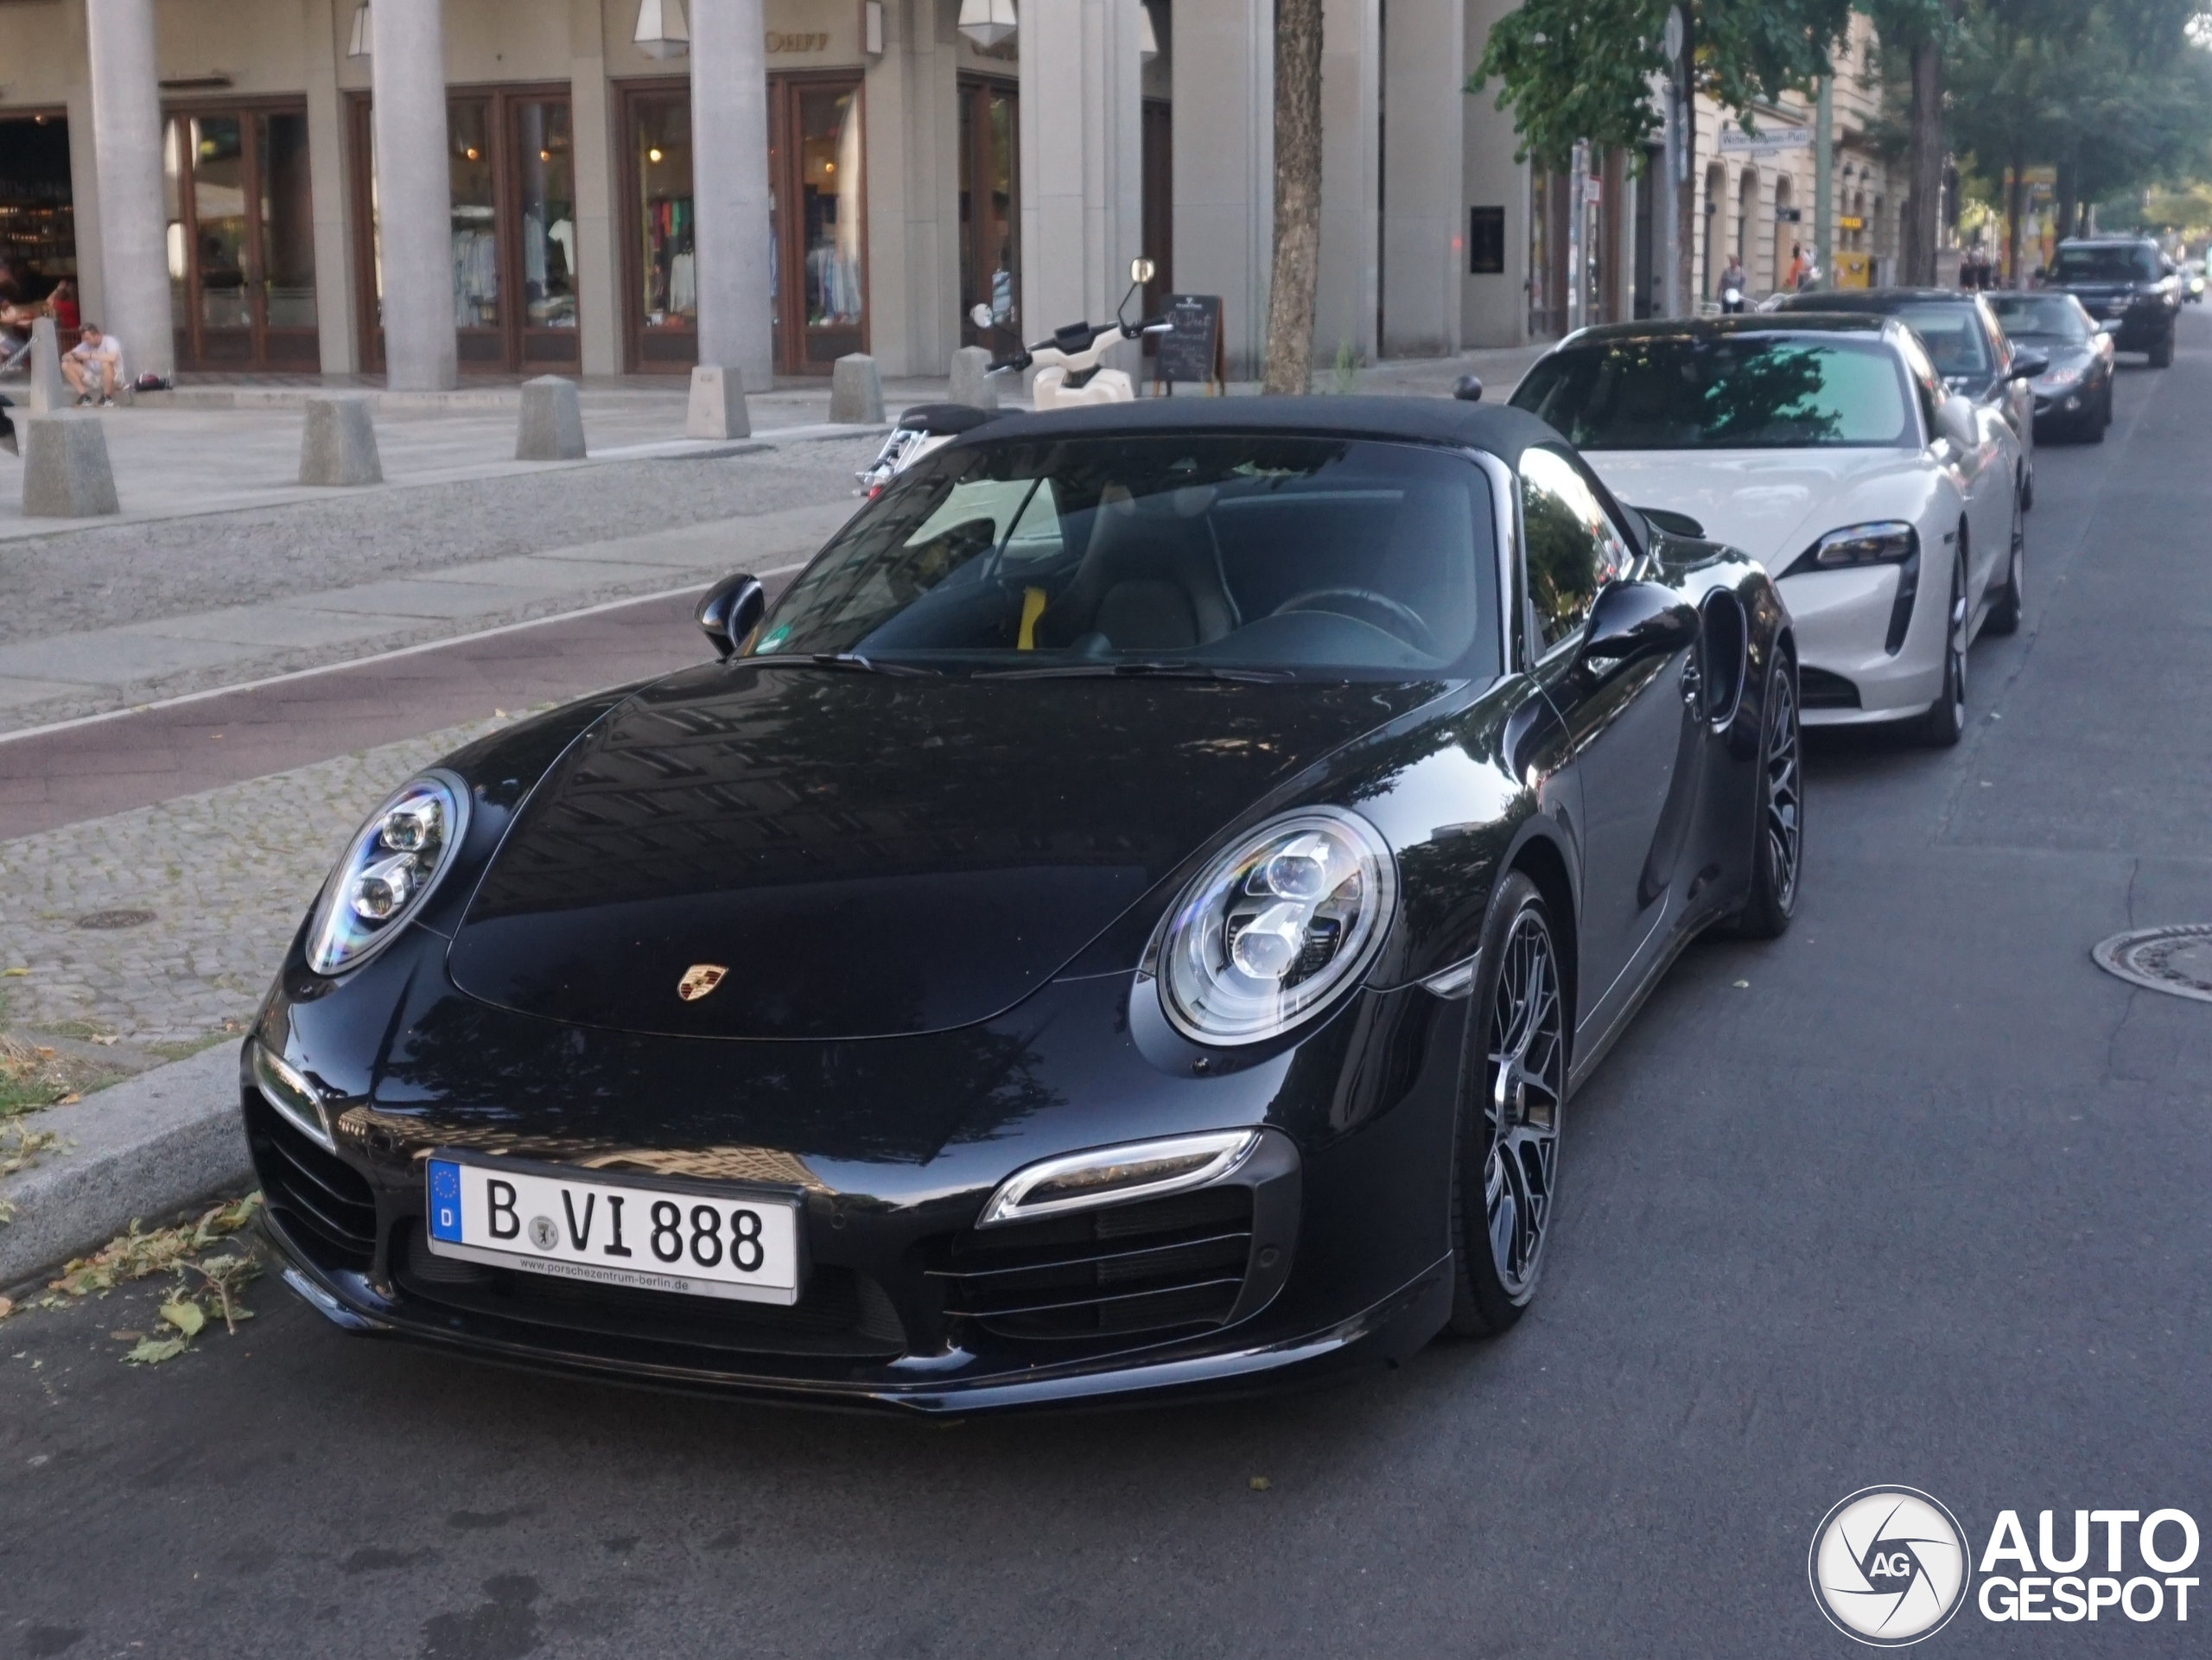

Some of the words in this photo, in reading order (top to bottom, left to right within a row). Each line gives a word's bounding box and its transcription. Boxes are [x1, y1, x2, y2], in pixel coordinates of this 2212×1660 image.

[441, 1208, 452, 1227] D
[487, 1179, 520, 1240] B
[562, 1189, 632, 1257] VI
[651, 1200, 764, 1272] 888
[520, 1259, 689, 1290] www.porschezentrum-berlin.de
